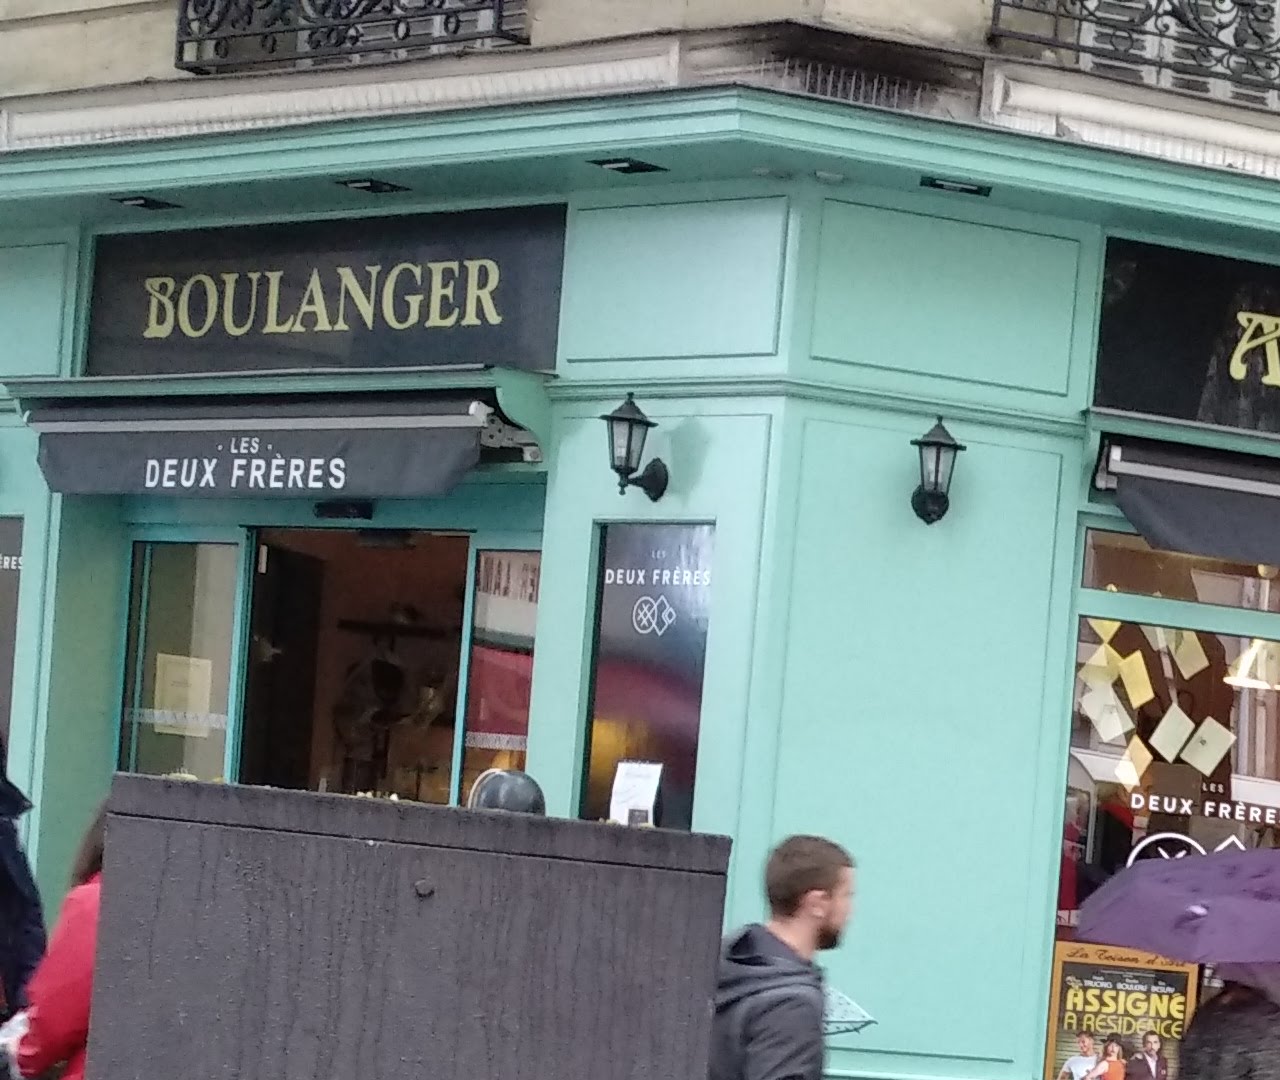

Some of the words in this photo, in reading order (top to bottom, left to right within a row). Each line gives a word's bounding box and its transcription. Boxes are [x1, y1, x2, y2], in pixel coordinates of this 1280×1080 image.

[142, 257, 503, 340] BOULANGER
[230, 436, 260, 454] LES
[144, 457, 218, 488] DEUX
[230, 453, 346, 490] FRÈRES
[651, 549, 667, 559] LES
[604, 568, 646, 585] DEUX
[652, 565, 711, 586] FRÈRES
[1202, 782, 1225, 794] LES
[1130, 793, 1194, 816] DEUX
[1066, 987, 1186, 1020] ASSIGNÉ
